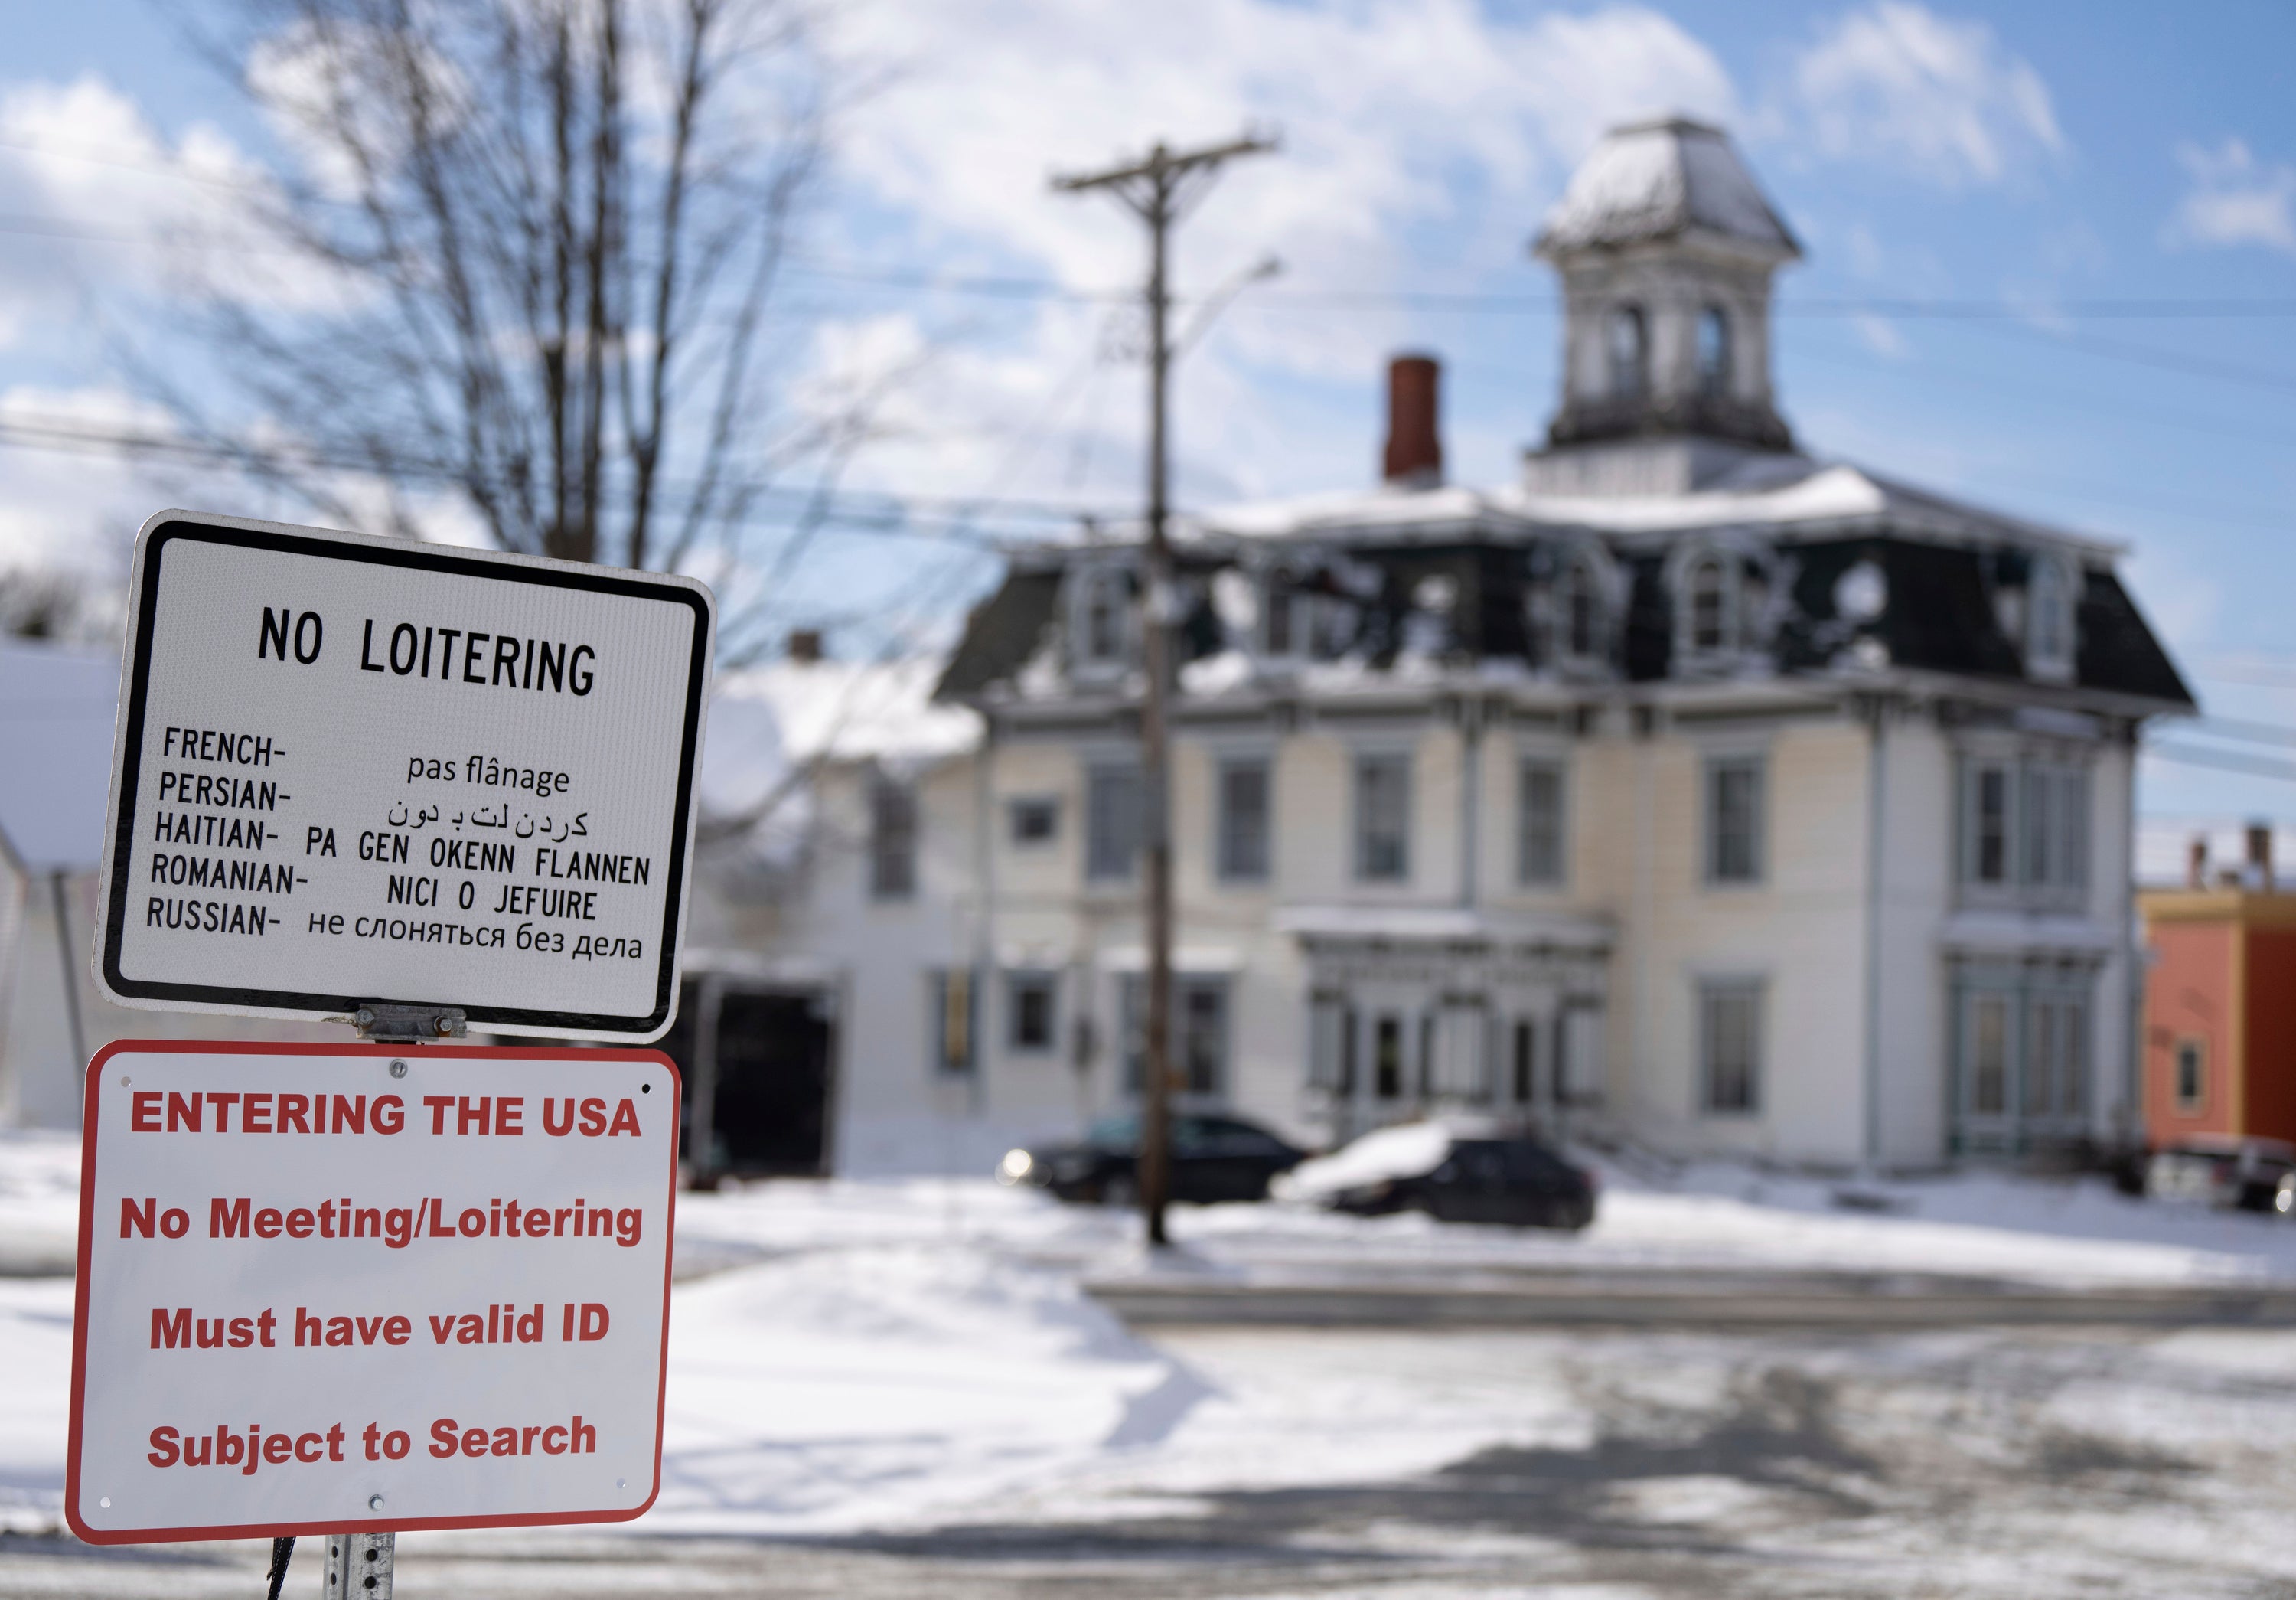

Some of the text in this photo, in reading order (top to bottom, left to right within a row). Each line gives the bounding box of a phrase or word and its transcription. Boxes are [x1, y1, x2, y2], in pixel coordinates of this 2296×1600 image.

[259, 606, 595, 697] NO LOITERING
[163, 727, 570, 798] FRENCH- pas flânage
[158, 771, 292, 811] PERSIAN-
[155, 811, 651, 886] HAITIAN- PA GEN OKENN FLANNEN
[151, 853, 308, 895] ROMANIAN-
[387, 874, 439, 907] NICI
[493, 884, 598, 921] JEFUIRE
[146, 896, 281, 936] RUSSIAN-
[308, 913, 643, 962] не слоняться без дела
[131, 1091, 642, 1138] ENTERING THE USA
[120, 1197, 643, 1249] No Meeting/Loitering
[151, 1303, 610, 1349] Must have valid ID
[148, 1416, 597, 1475] Subject to Search
